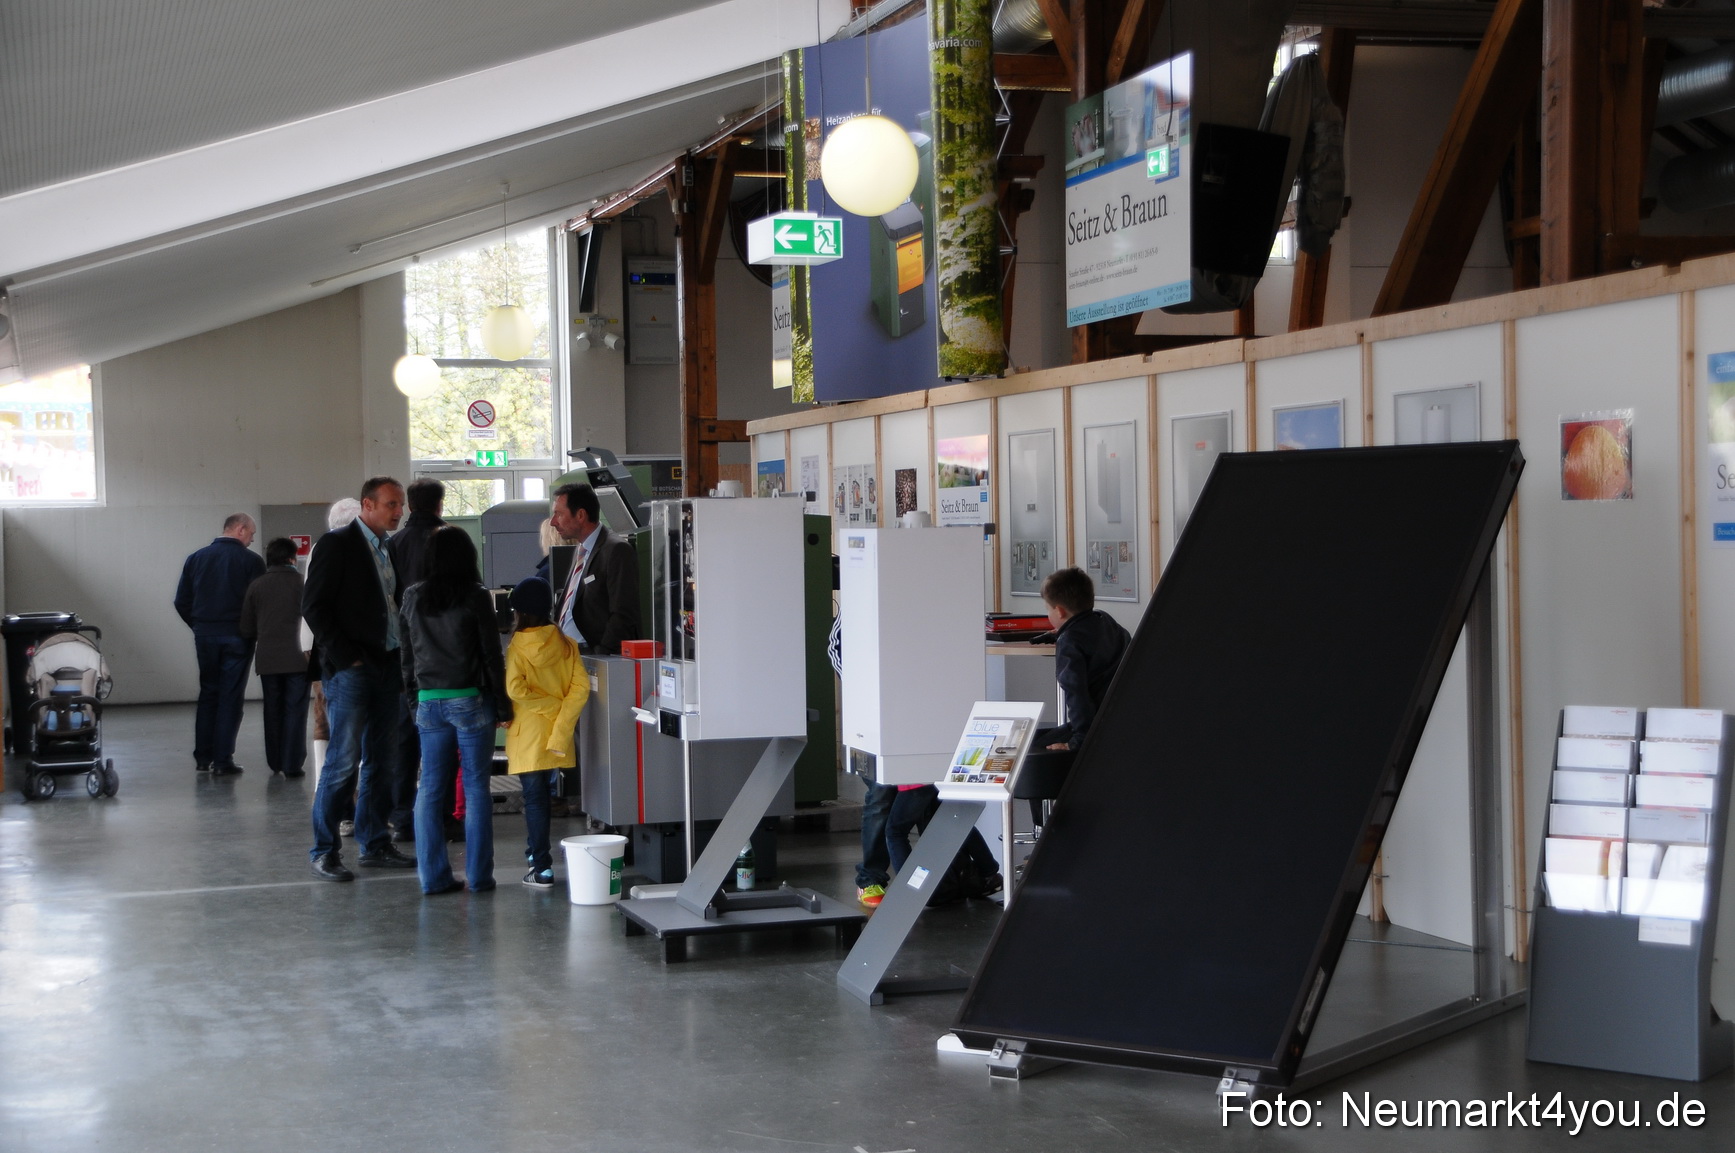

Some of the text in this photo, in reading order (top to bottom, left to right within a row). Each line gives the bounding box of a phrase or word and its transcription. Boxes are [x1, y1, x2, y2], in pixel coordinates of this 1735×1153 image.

[826, 111, 869, 127] Heizanl
[1068, 194, 1168, 246] Seitz & Braun
[774, 305, 791, 331] Seitz
[941, 498, 979, 514] Seitz & Braun
[973, 720, 1000, 733] blue
